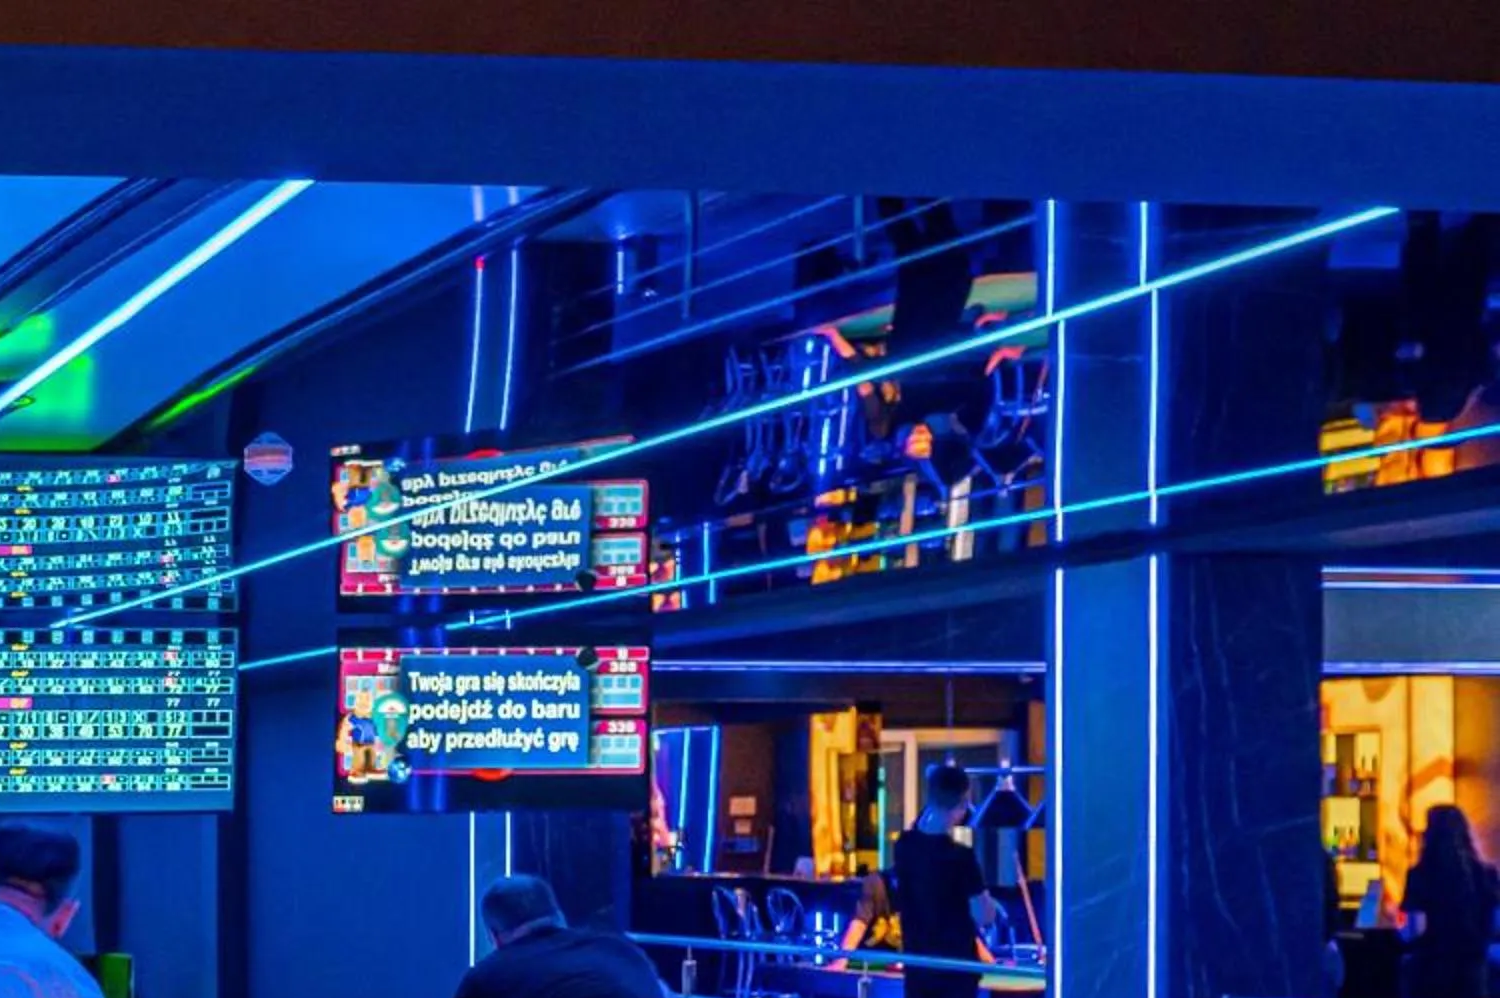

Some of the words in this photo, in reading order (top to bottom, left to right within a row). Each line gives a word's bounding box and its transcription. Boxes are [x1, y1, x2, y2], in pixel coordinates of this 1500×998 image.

[408, 671, 452, 697] Twoja
[455, 674, 481, 697] gra
[483, 670, 505, 696] się
[508, 670, 581, 696] skończyła
[408, 699, 493, 725] podejdź
[498, 699, 527, 719] do
[532, 699, 581, 719] baru
[407, 727, 441, 753] aby
[445, 727, 545, 753] przedłużyć
[548, 731, 579, 753] grę
